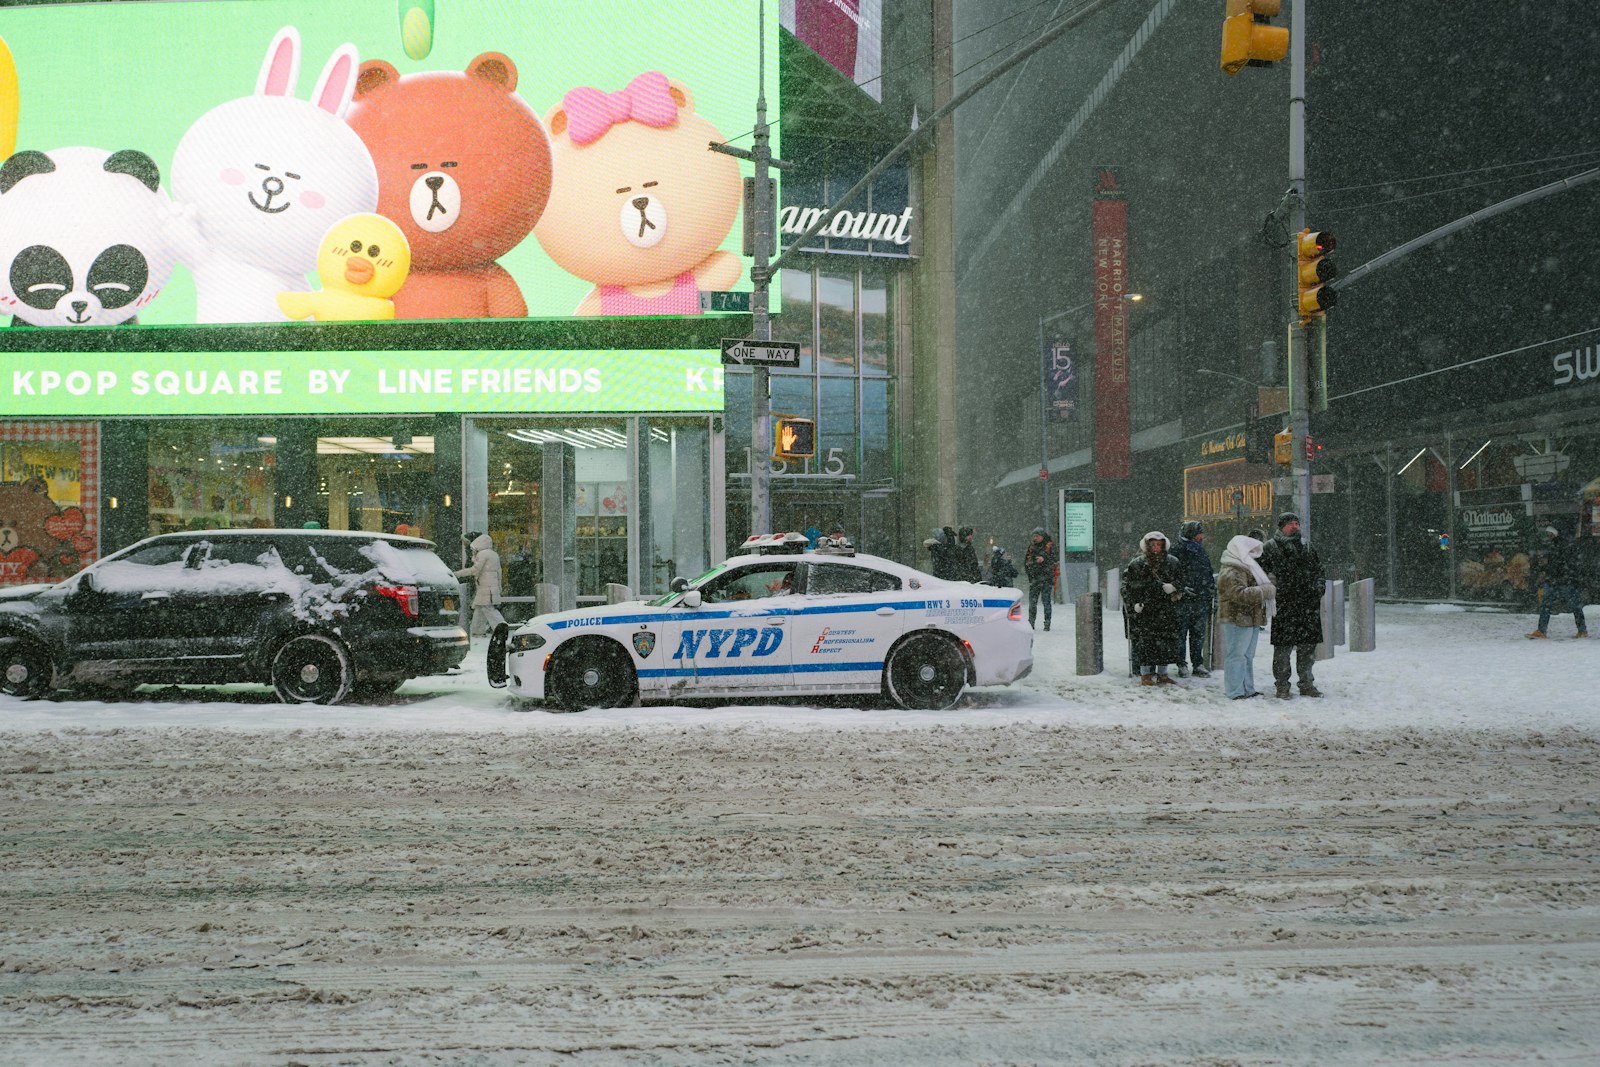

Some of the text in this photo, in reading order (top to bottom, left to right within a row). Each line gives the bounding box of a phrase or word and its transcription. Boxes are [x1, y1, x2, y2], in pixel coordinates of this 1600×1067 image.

[1099, 239, 1108, 310] NEW YORK
[720, 294, 728, 308] 7
[733, 347, 790, 360] ONE WAY
[1113, 317, 1123, 381] MARQUIS
[1051, 347, 1071, 370] 15
[13, 368, 600, 395] KPOP SQUARE BY LINE FRIENDS
[24, 463, 56, 480] NEW
[1463, 508, 1514, 526] Nathan's
[927, 600, 951, 609] HWY 3
[960, 599, 978, 608] 5960
[567, 617, 601, 628] POLICE
[822, 627, 856, 635] COURTESY
[672, 627, 784, 659] NYPD
[816, 636, 875, 644] PROFESSIONALISM
[811, 645, 842, 653] RESPECT
